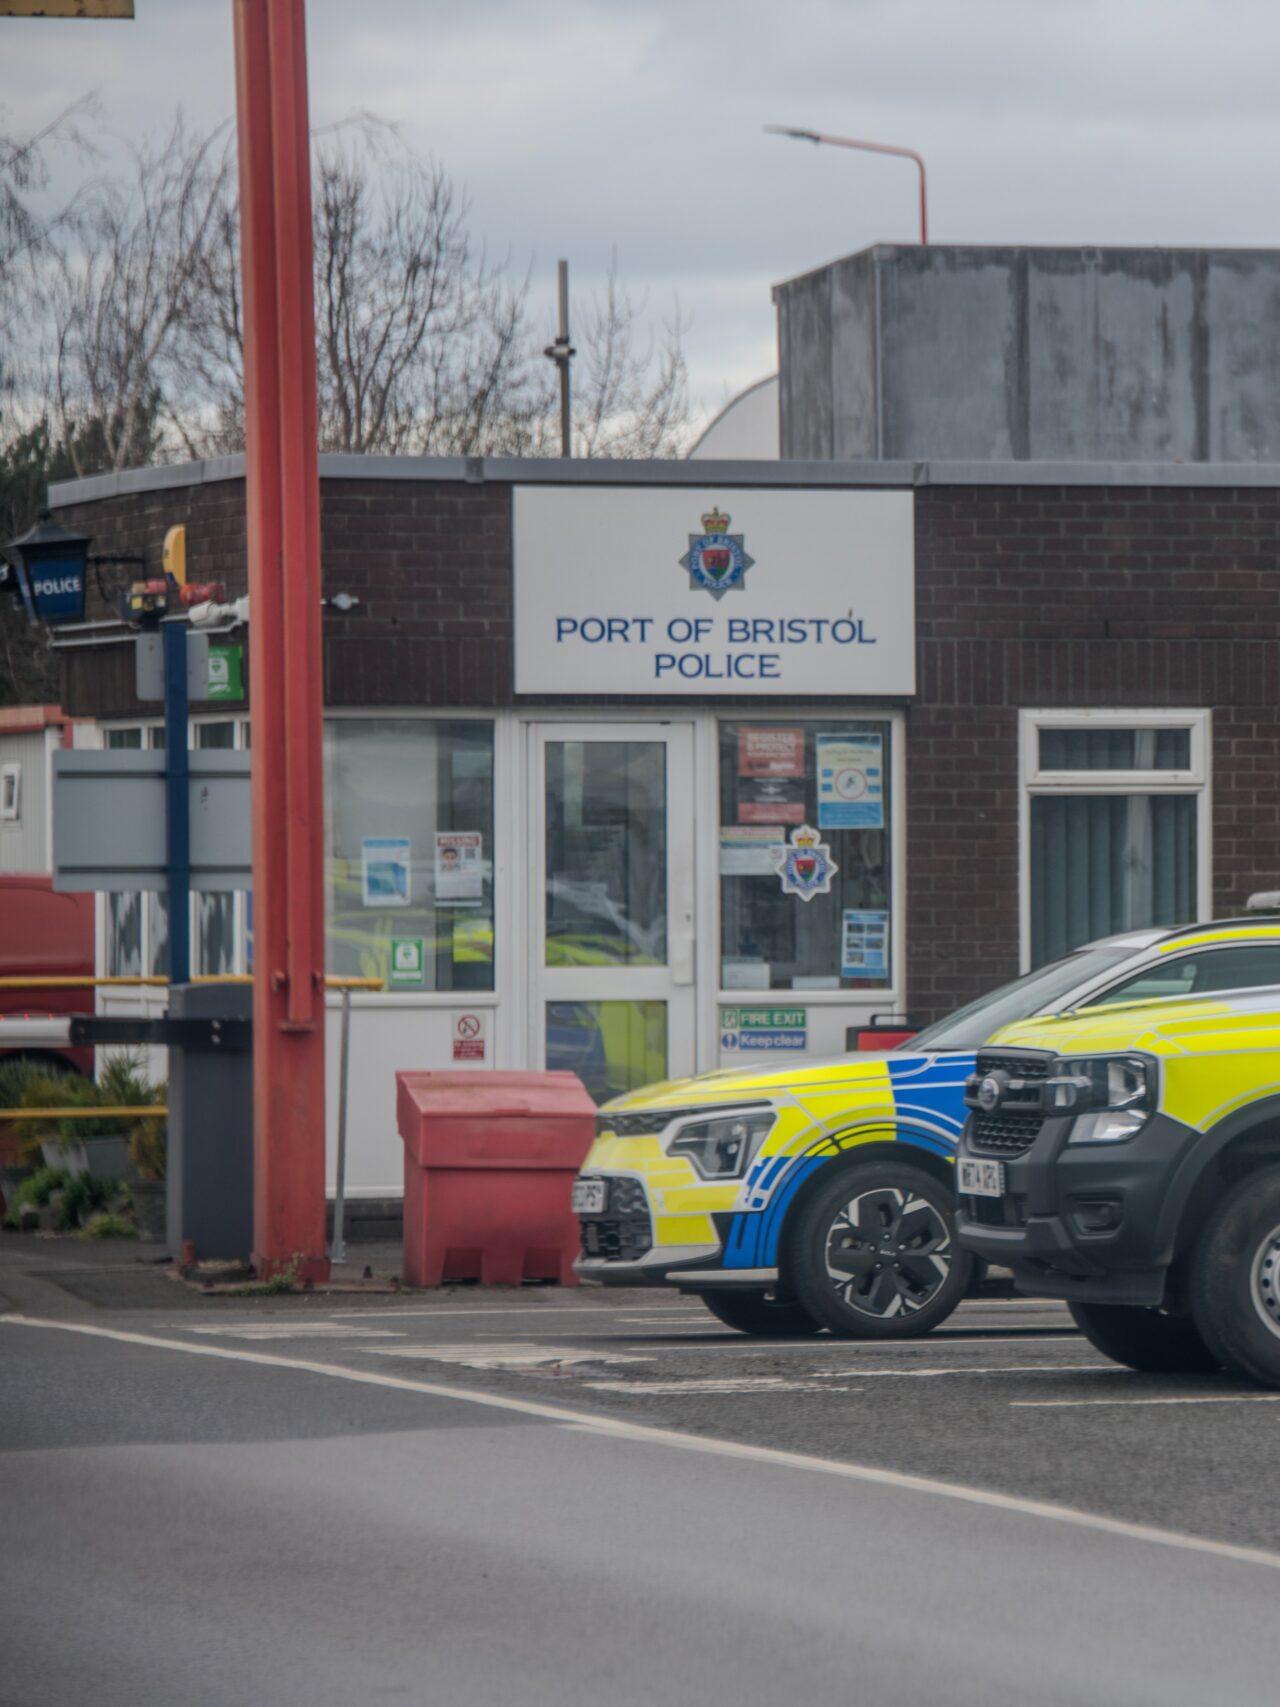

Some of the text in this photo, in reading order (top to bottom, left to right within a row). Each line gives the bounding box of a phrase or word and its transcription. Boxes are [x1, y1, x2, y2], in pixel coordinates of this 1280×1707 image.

[34, 576, 81, 596] POLICE
[556, 618, 877, 644] PORT OF BRISTOL
[654, 653, 781, 679] POLICE
[439, 837, 477, 847] MISSING
[741, 1012, 803, 1024] FIRE EXIT
[741, 1033, 804, 1048] Keep clear
